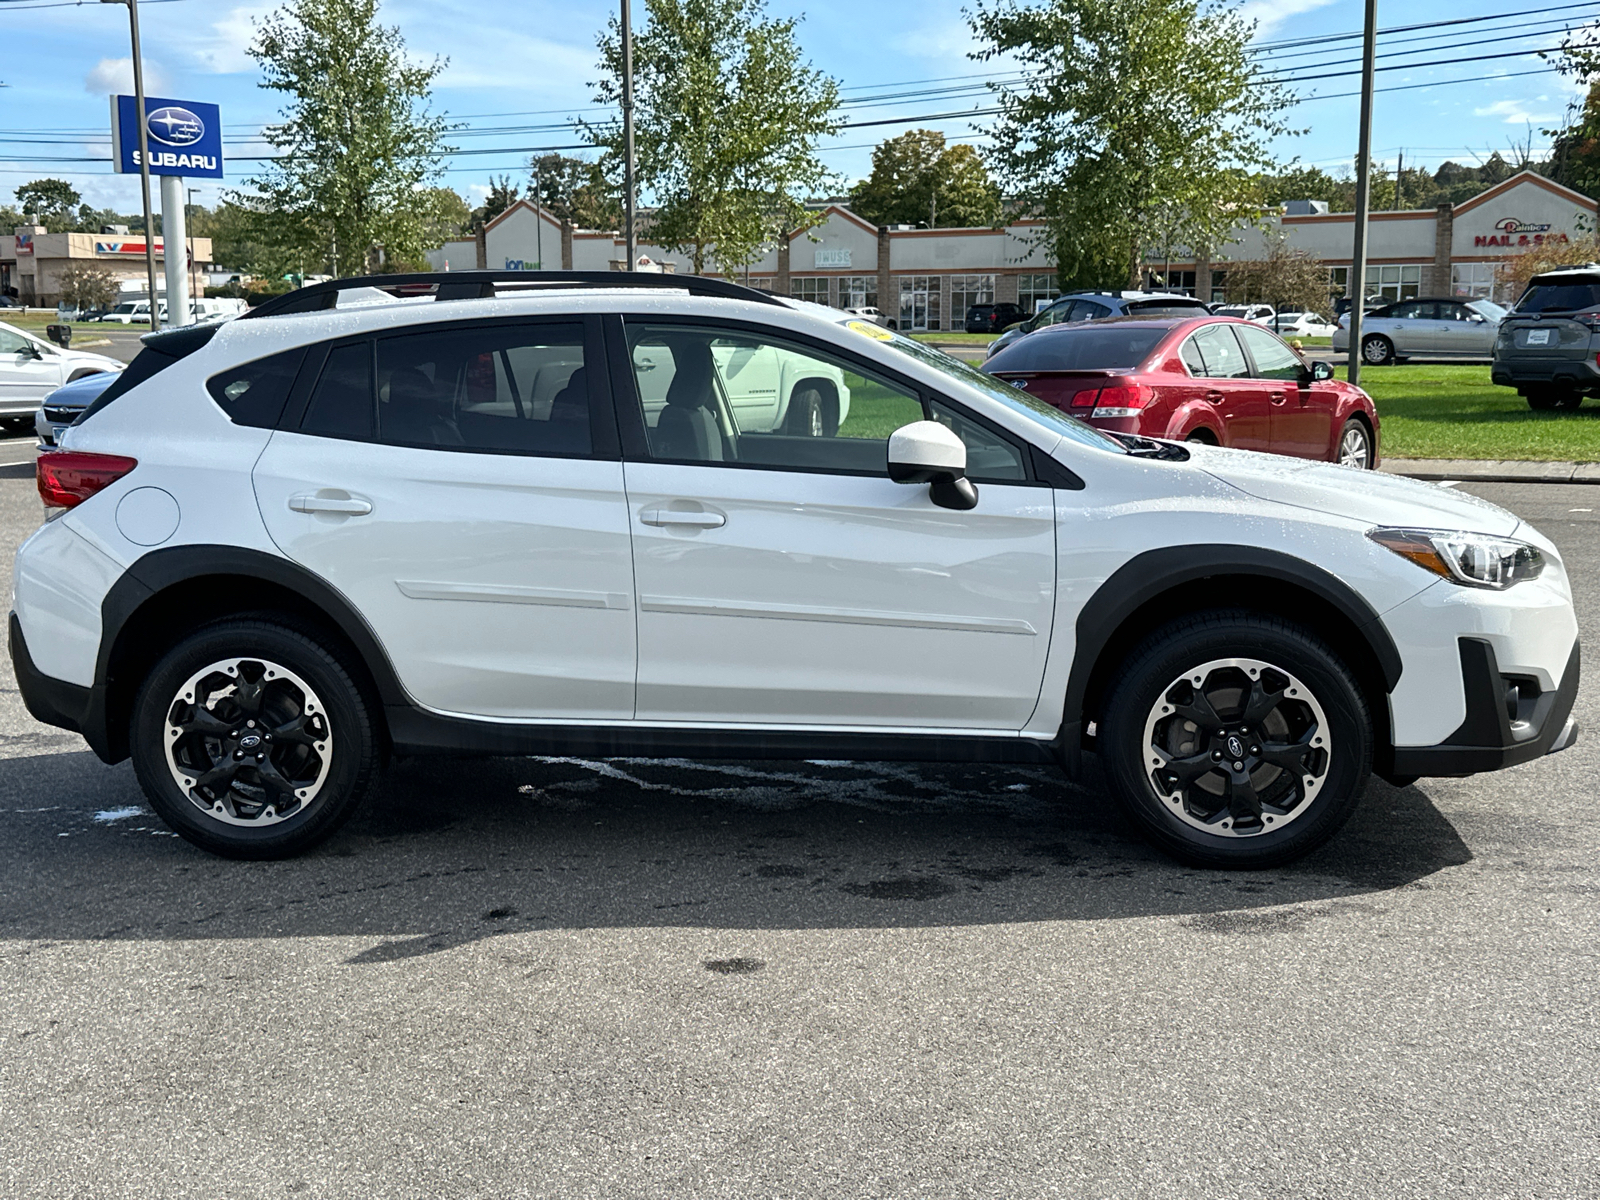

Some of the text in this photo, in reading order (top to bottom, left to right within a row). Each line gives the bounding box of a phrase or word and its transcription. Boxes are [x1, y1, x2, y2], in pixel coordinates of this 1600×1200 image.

[132, 150, 217, 170] SUBARU
[1505, 221, 1551, 233] Rainbow
[1474, 235, 1515, 247] NAIL
[1518, 235, 1530, 246] &
